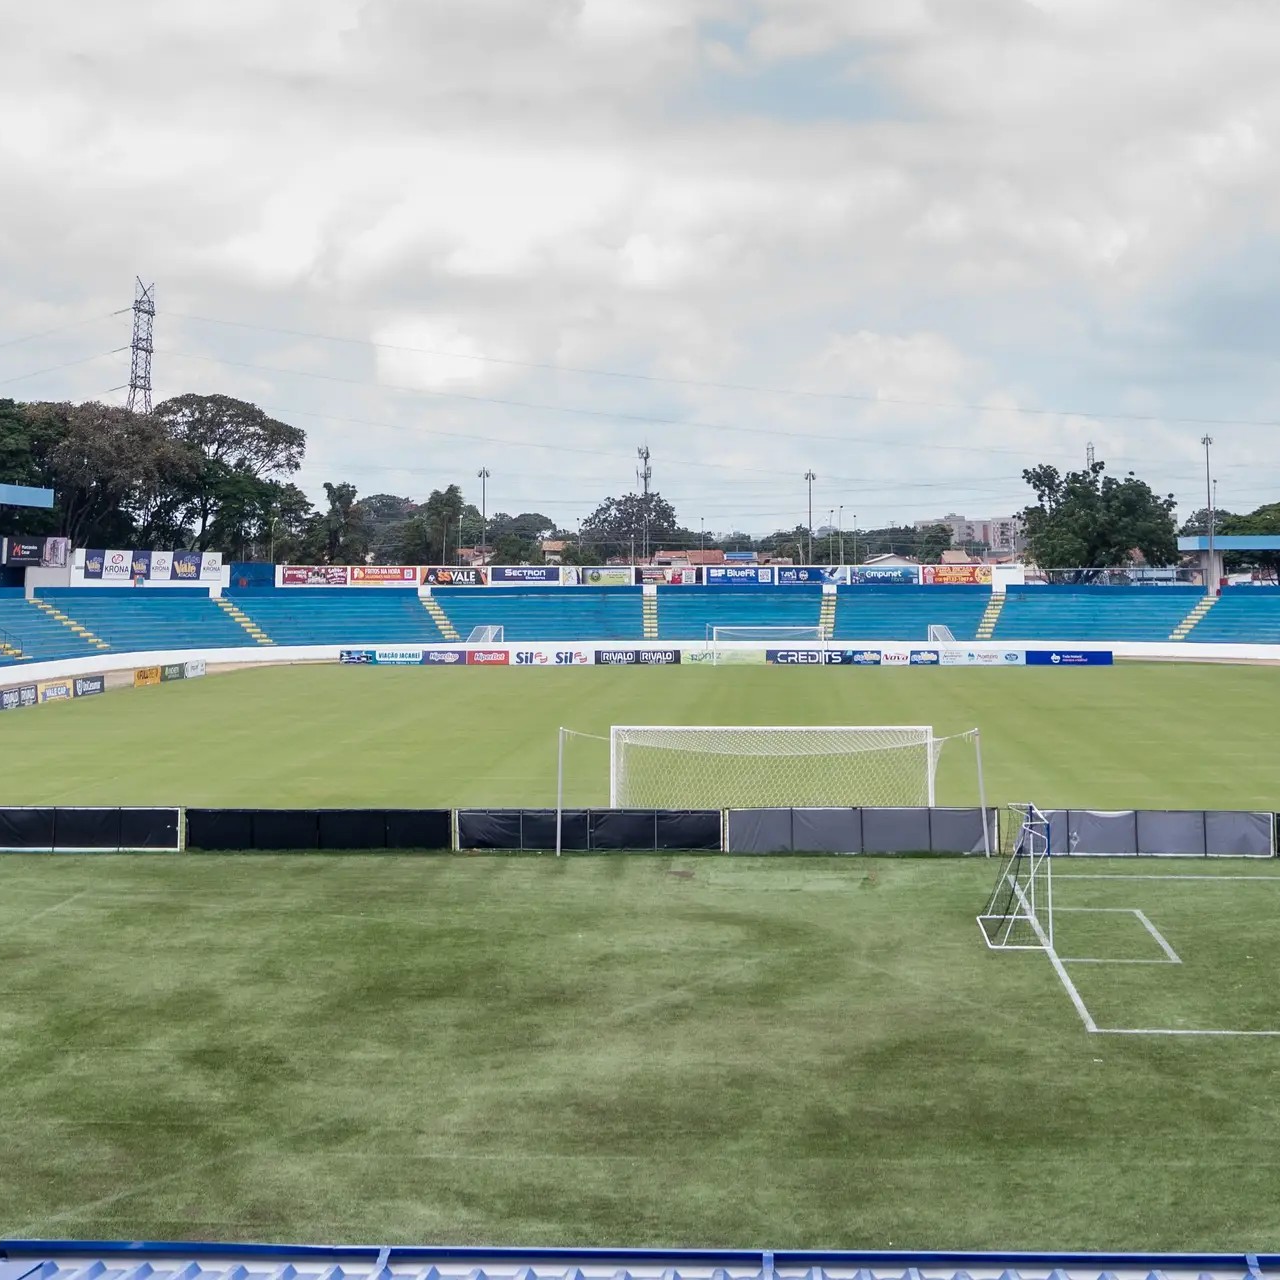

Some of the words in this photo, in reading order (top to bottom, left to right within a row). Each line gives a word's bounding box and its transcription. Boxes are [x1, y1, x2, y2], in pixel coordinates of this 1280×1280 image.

[104, 565, 129, 573] KRONA
[727, 568, 755, 577] BlueFit
[516, 651, 533, 663] Sil
[555, 651, 573, 663] Sil
[602, 651, 633, 661] RIVALO
[642, 651, 673, 660] RIVALO
[777, 651, 842, 663] CREDITS
